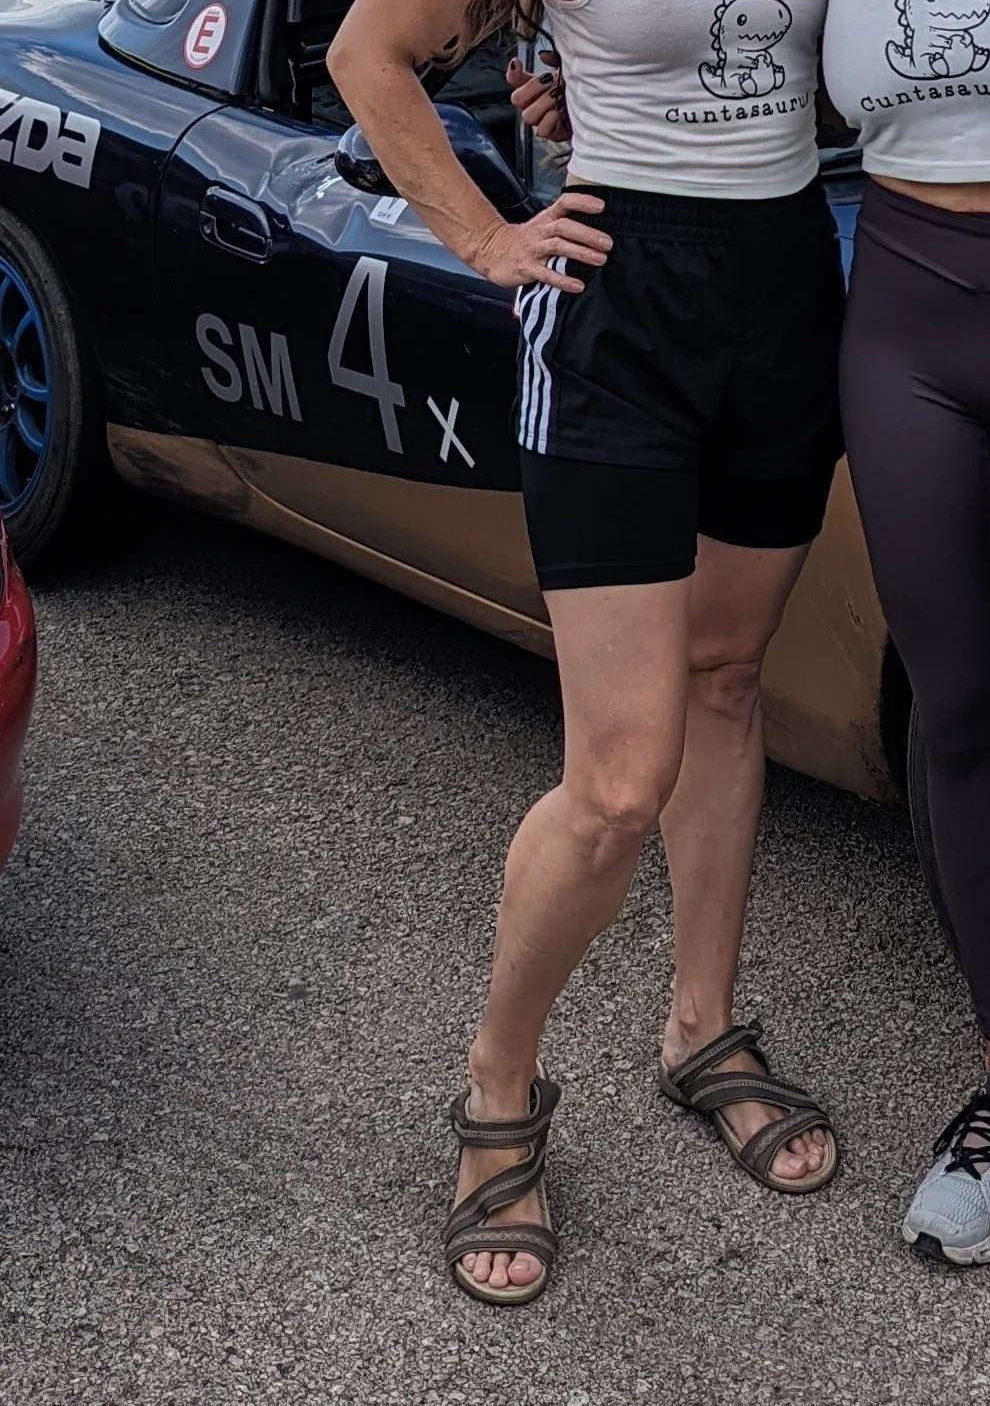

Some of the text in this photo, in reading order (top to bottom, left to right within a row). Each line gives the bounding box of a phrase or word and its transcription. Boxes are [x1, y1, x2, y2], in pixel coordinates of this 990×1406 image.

[192, 15, 220, 54] E
[665, 92, 809, 123] Cuntasauru
[195, 313, 302, 422] SM
[327, 255, 406, 455] 4
